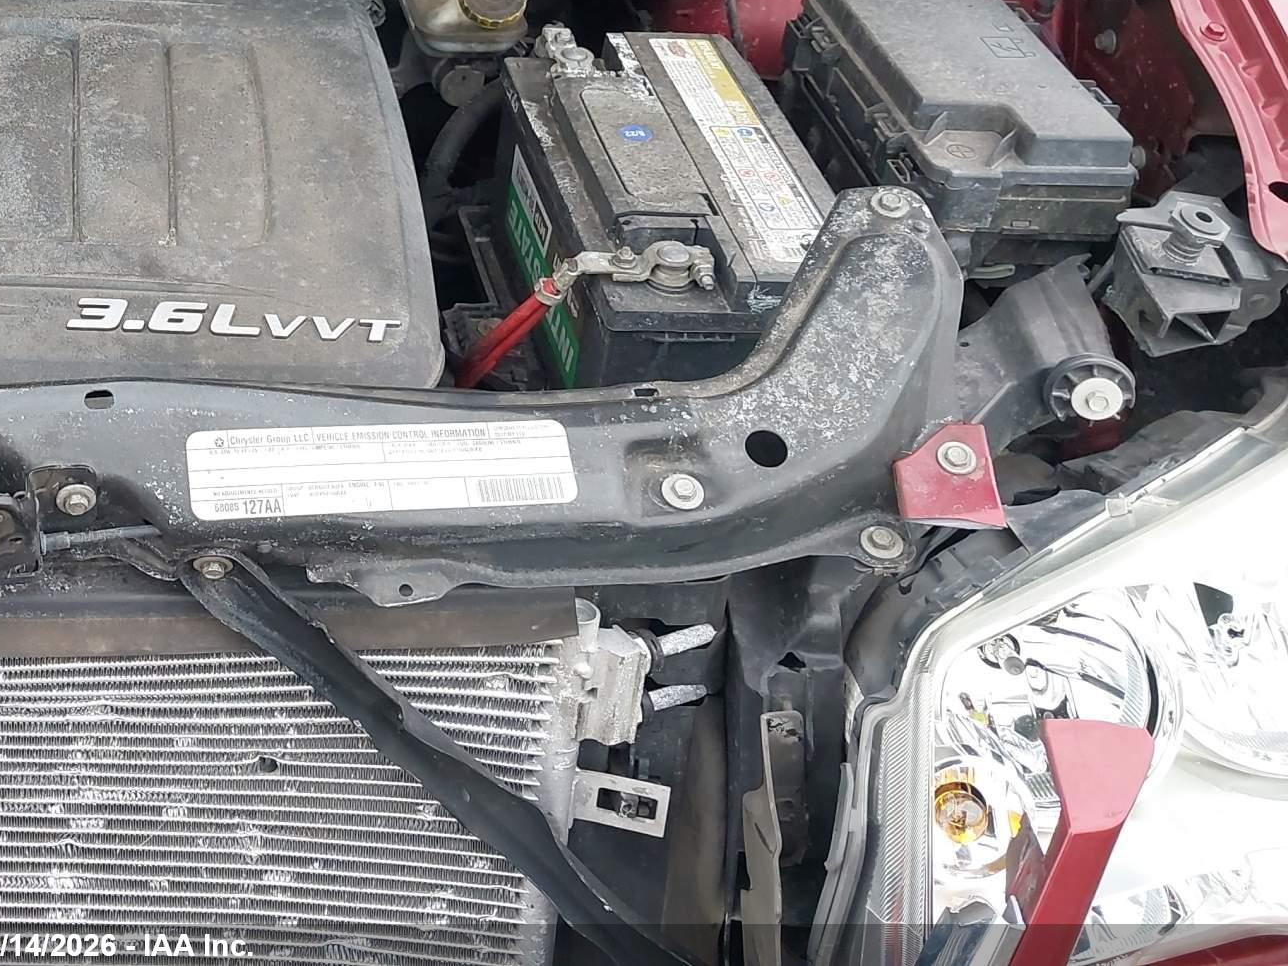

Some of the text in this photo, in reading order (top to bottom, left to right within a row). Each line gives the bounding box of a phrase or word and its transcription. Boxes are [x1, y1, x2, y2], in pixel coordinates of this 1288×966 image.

[230, 433, 310, 446] Chrysler Group LLC
[316, 432, 349, 442] VEHICLE
[352, 430, 390, 441] EMISSION
[392, 429, 428, 440] CONTROL
[431, 427, 486, 439] INFORMATION
[243, 498, 282, 515] 127AA
